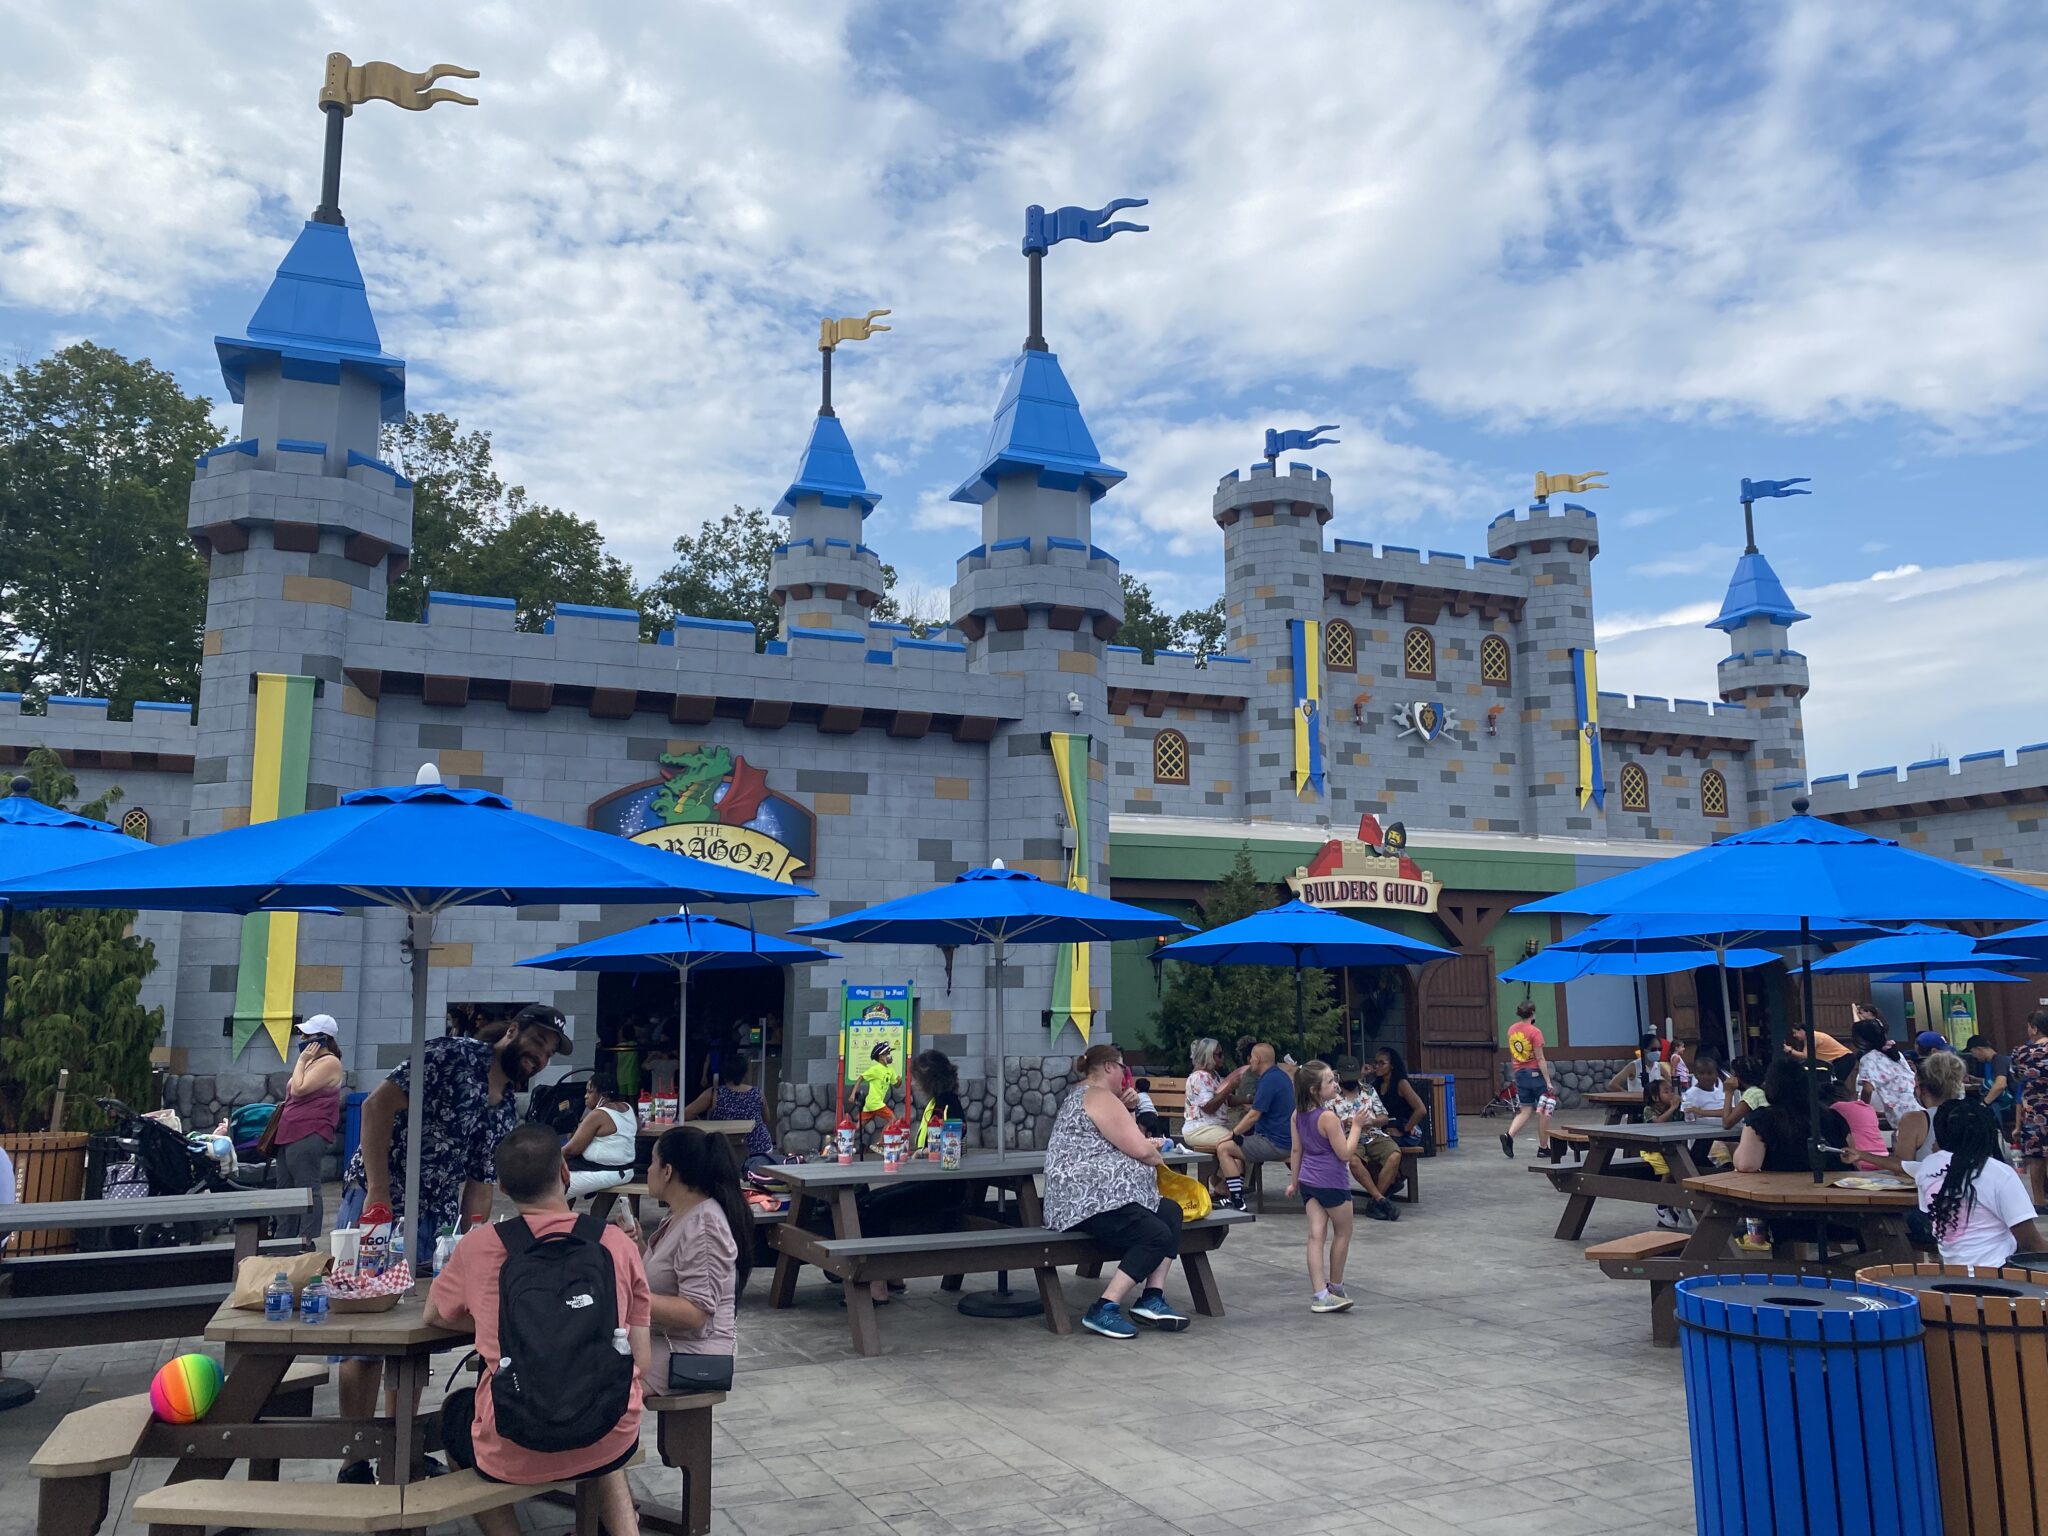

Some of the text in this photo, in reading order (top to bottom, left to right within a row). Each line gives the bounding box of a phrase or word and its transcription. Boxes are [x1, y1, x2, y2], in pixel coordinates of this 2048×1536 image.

[694, 826, 722, 837] THE
[646, 837, 774, 872] RAGON
[1302, 881, 1428, 906] BUILDERS GUILD
